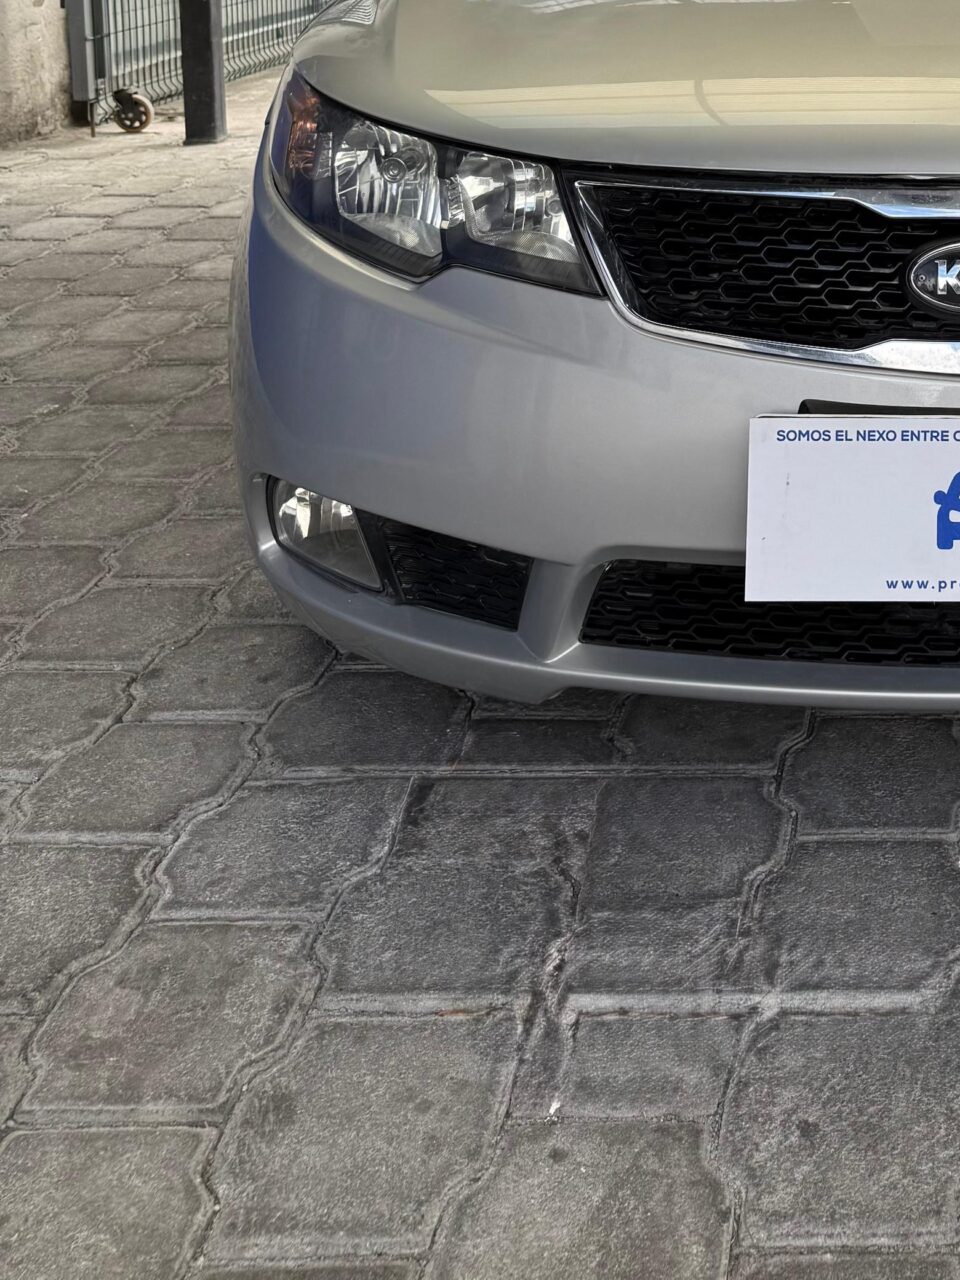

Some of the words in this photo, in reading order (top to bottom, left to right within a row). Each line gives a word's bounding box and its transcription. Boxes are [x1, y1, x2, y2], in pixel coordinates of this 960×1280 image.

[776, 429, 832, 442] SOMOS
[835, 429, 853, 442] EL
[856, 429, 897, 442] NEXO
[901, 429, 950, 442] ENTRE
